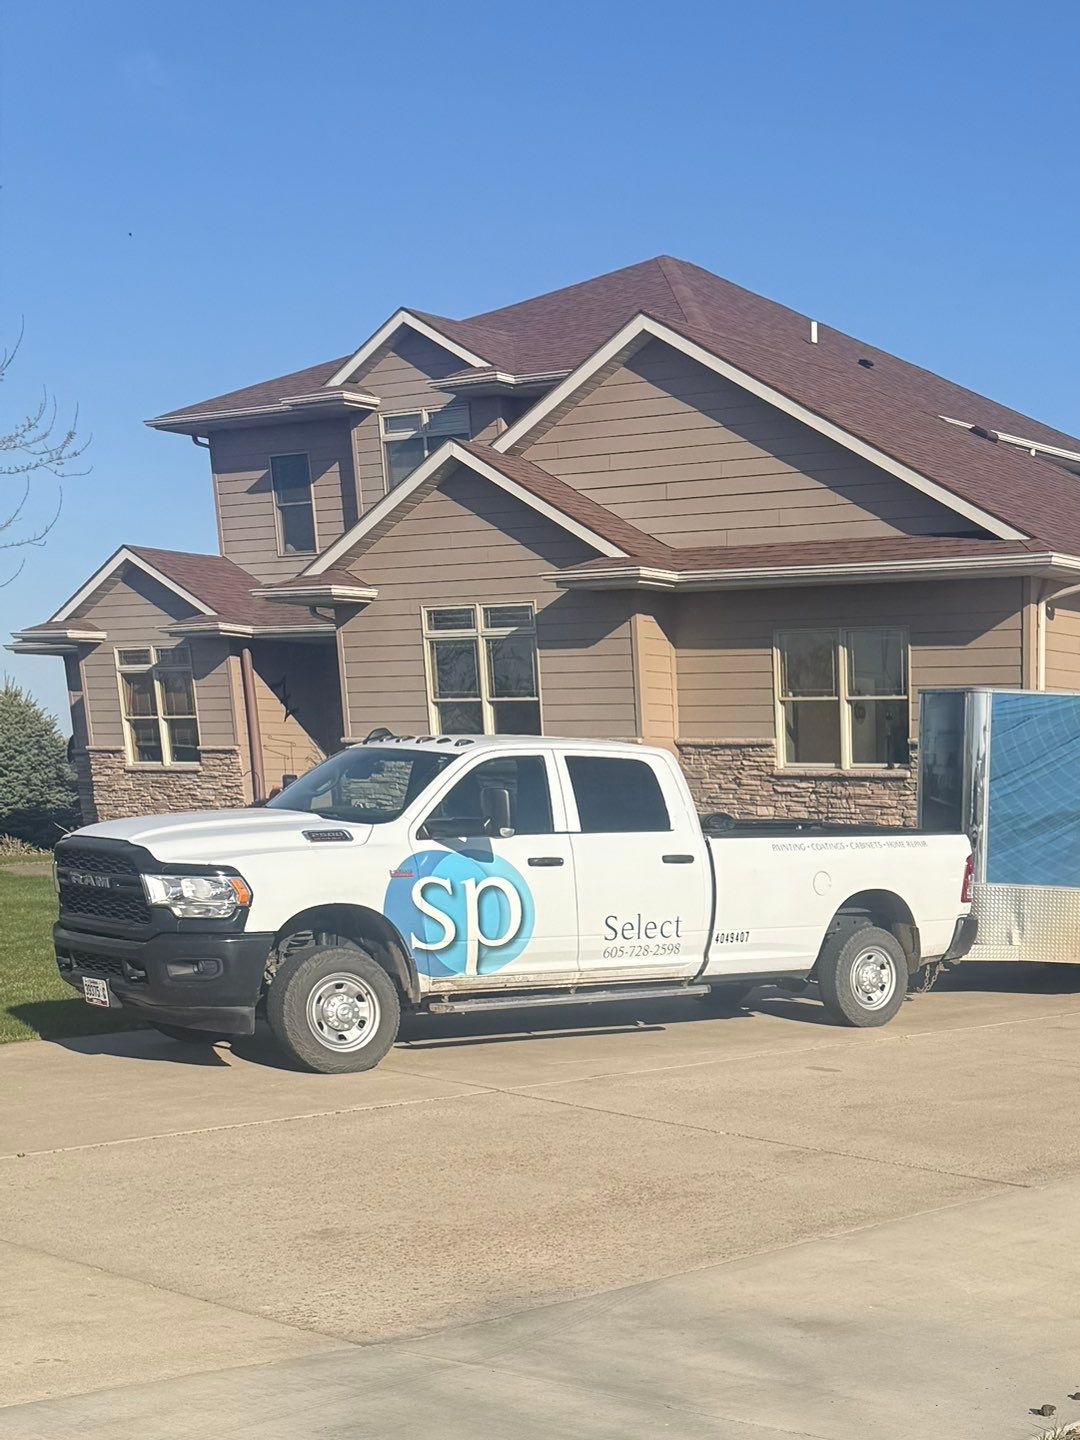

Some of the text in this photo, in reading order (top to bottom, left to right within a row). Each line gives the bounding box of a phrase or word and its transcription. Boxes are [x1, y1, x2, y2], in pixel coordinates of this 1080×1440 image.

[772, 843, 806, 852] PAINTING
[811, 842, 847, 851] COATINGS
[850, 841, 882, 850] CABINETS
[906, 840, 928, 848] REPAIR
[70, 871, 110, 888] RAM
[411, 876, 522, 976] sp
[604, 913, 683, 941] Select
[715, 931, 750, 944] 4049407
[603, 942, 681, 959] 605-728-2598
